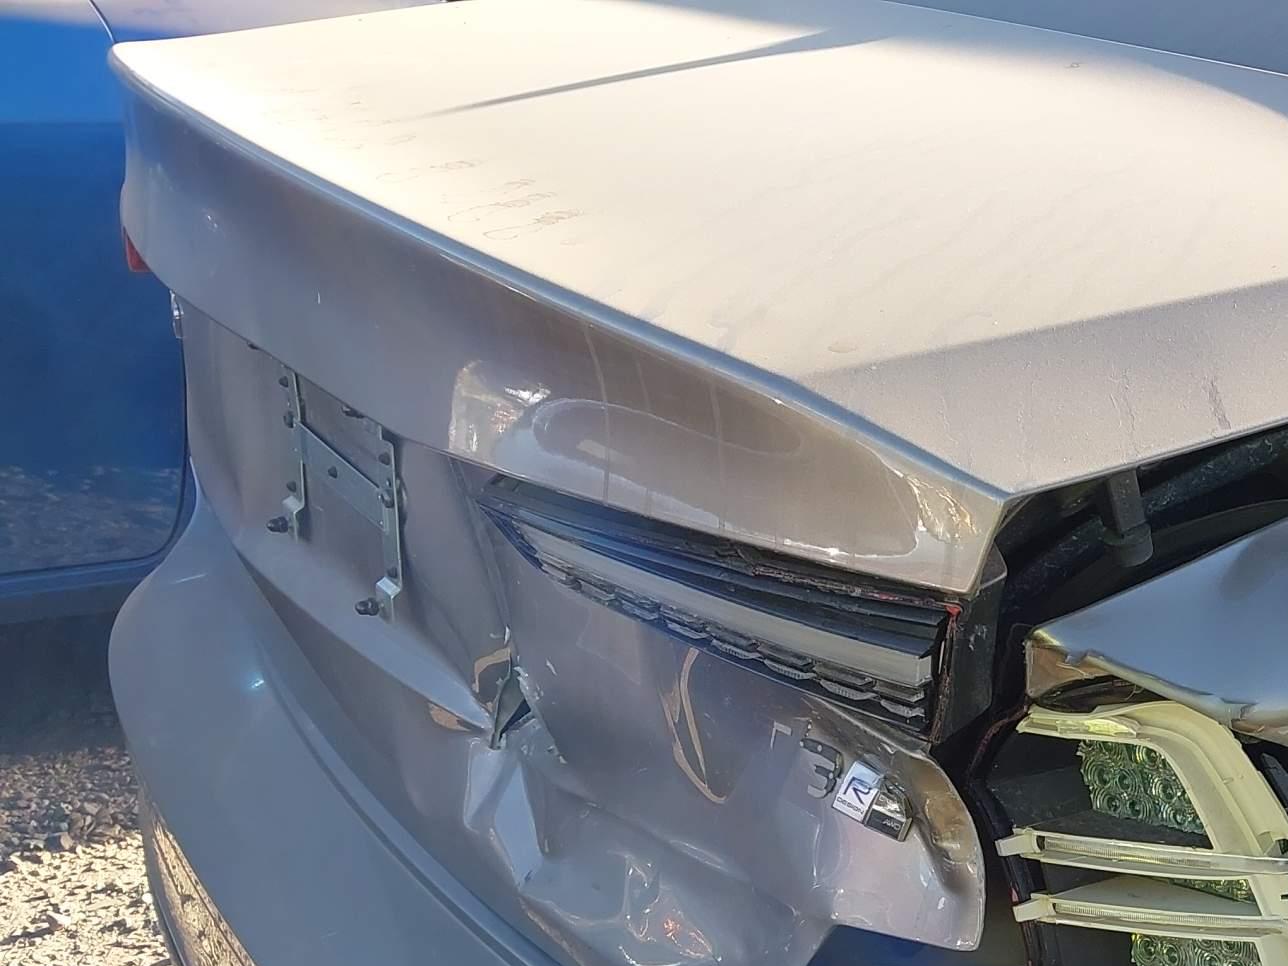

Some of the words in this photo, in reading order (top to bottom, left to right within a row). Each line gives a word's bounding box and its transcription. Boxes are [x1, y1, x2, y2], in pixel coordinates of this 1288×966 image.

[842, 776, 873, 806] R
[836, 795, 865, 816] DESIGN
[881, 818, 901, 831] AWD
